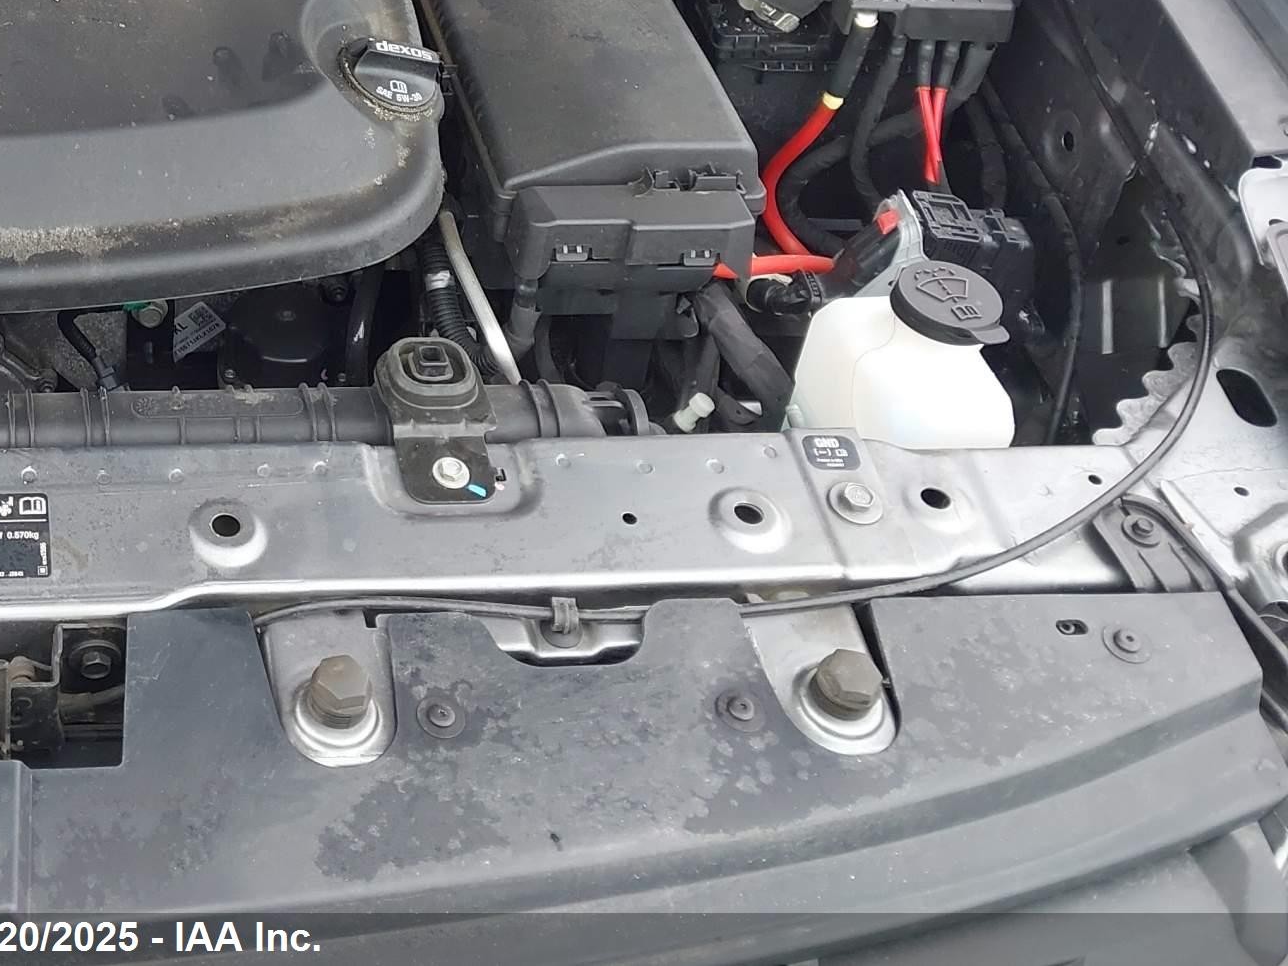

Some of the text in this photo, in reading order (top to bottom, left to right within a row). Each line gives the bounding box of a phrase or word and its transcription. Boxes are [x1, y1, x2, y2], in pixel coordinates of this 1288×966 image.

[376, 40, 433, 61] dexos
[376, 86, 393, 99] SAE
[814, 438, 839, 447] GND
